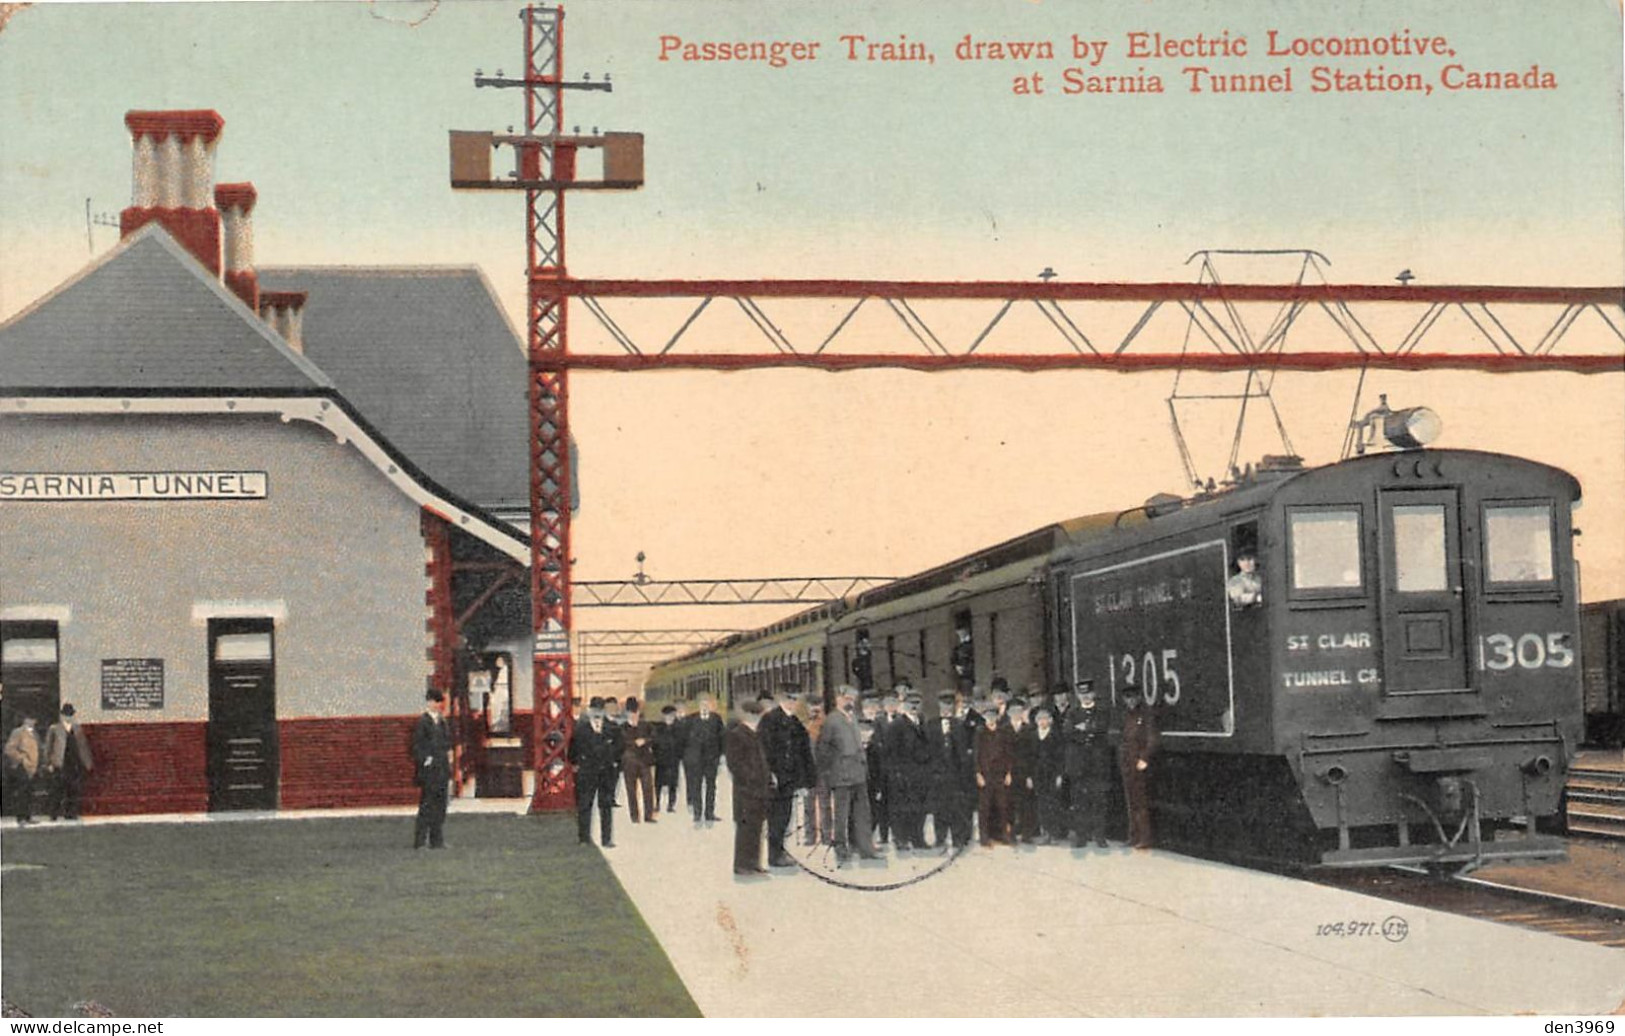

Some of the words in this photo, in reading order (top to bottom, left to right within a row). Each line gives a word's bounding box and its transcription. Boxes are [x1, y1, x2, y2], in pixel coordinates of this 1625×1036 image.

[0, 475, 116, 496] SARNIA
[129, 475, 257, 495] TUNNEL
[1318, 633, 1371, 648] CLAIR
[1478, 632, 1574, 671] 1305
[1283, 670, 1352, 687] TUNNEL
